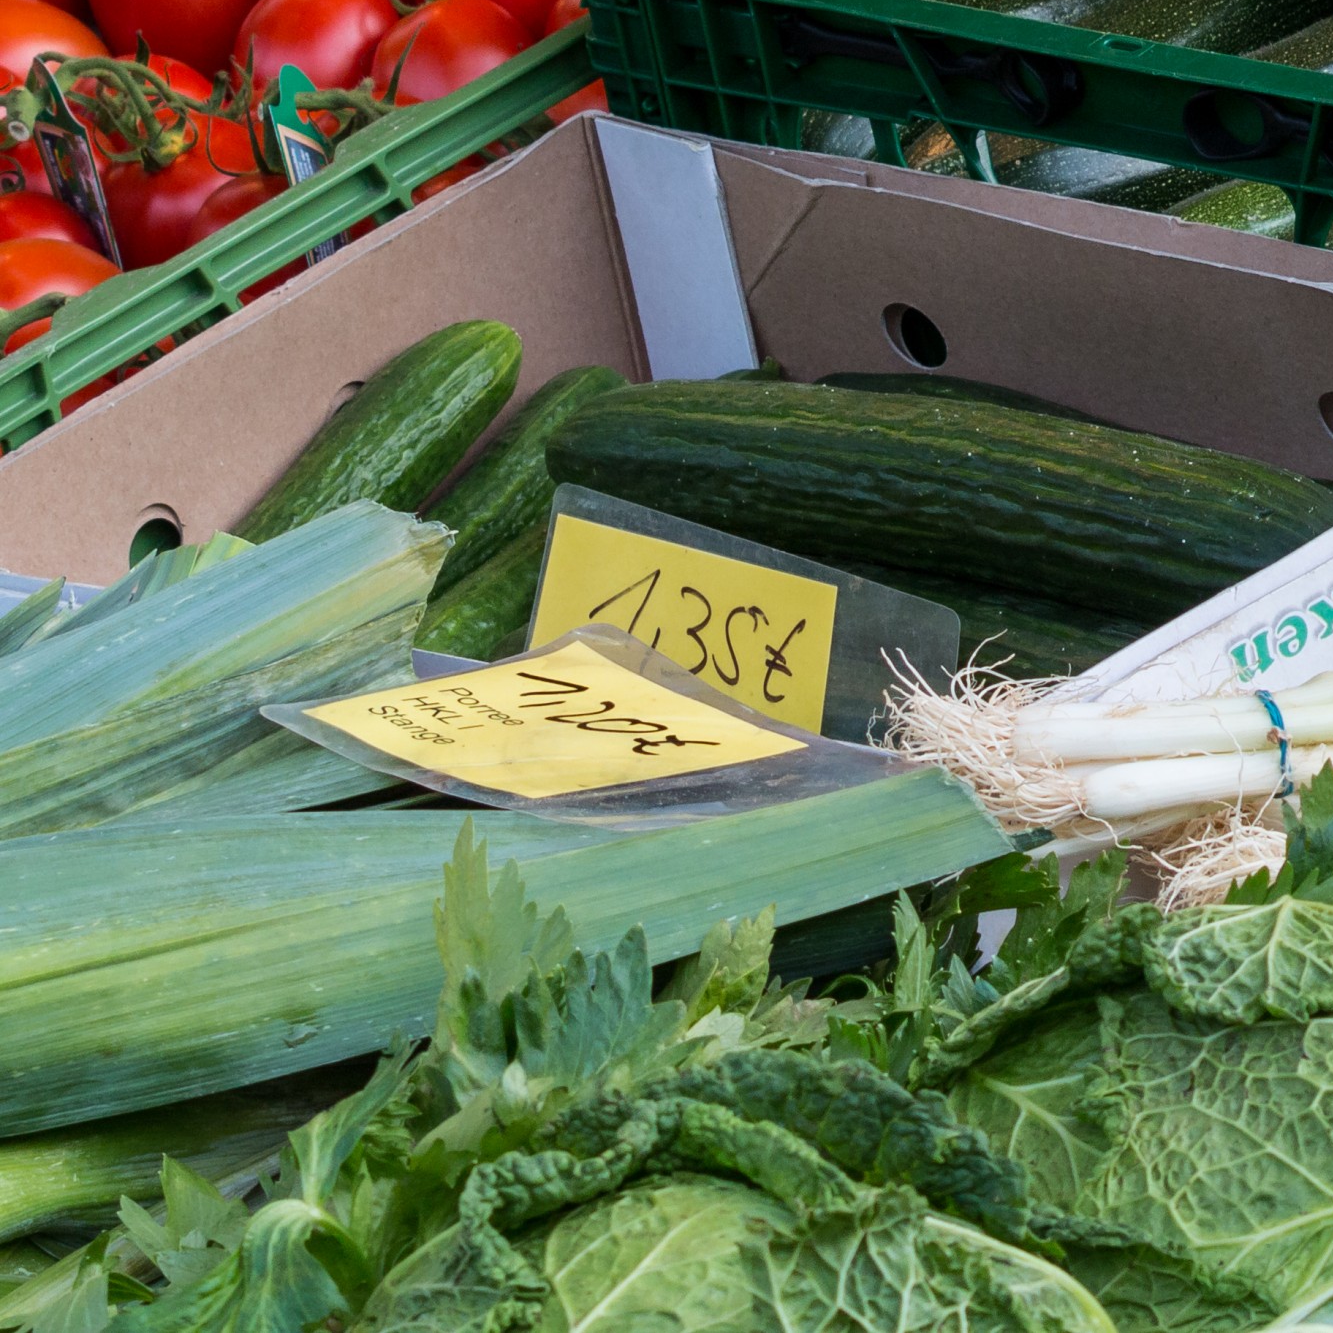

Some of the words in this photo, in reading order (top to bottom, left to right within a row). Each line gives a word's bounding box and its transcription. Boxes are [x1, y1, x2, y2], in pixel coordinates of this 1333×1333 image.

[367, 703, 456, 746] Stange
[401, 695, 462, 726] HKL
[438, 685, 525, 728] Porree
